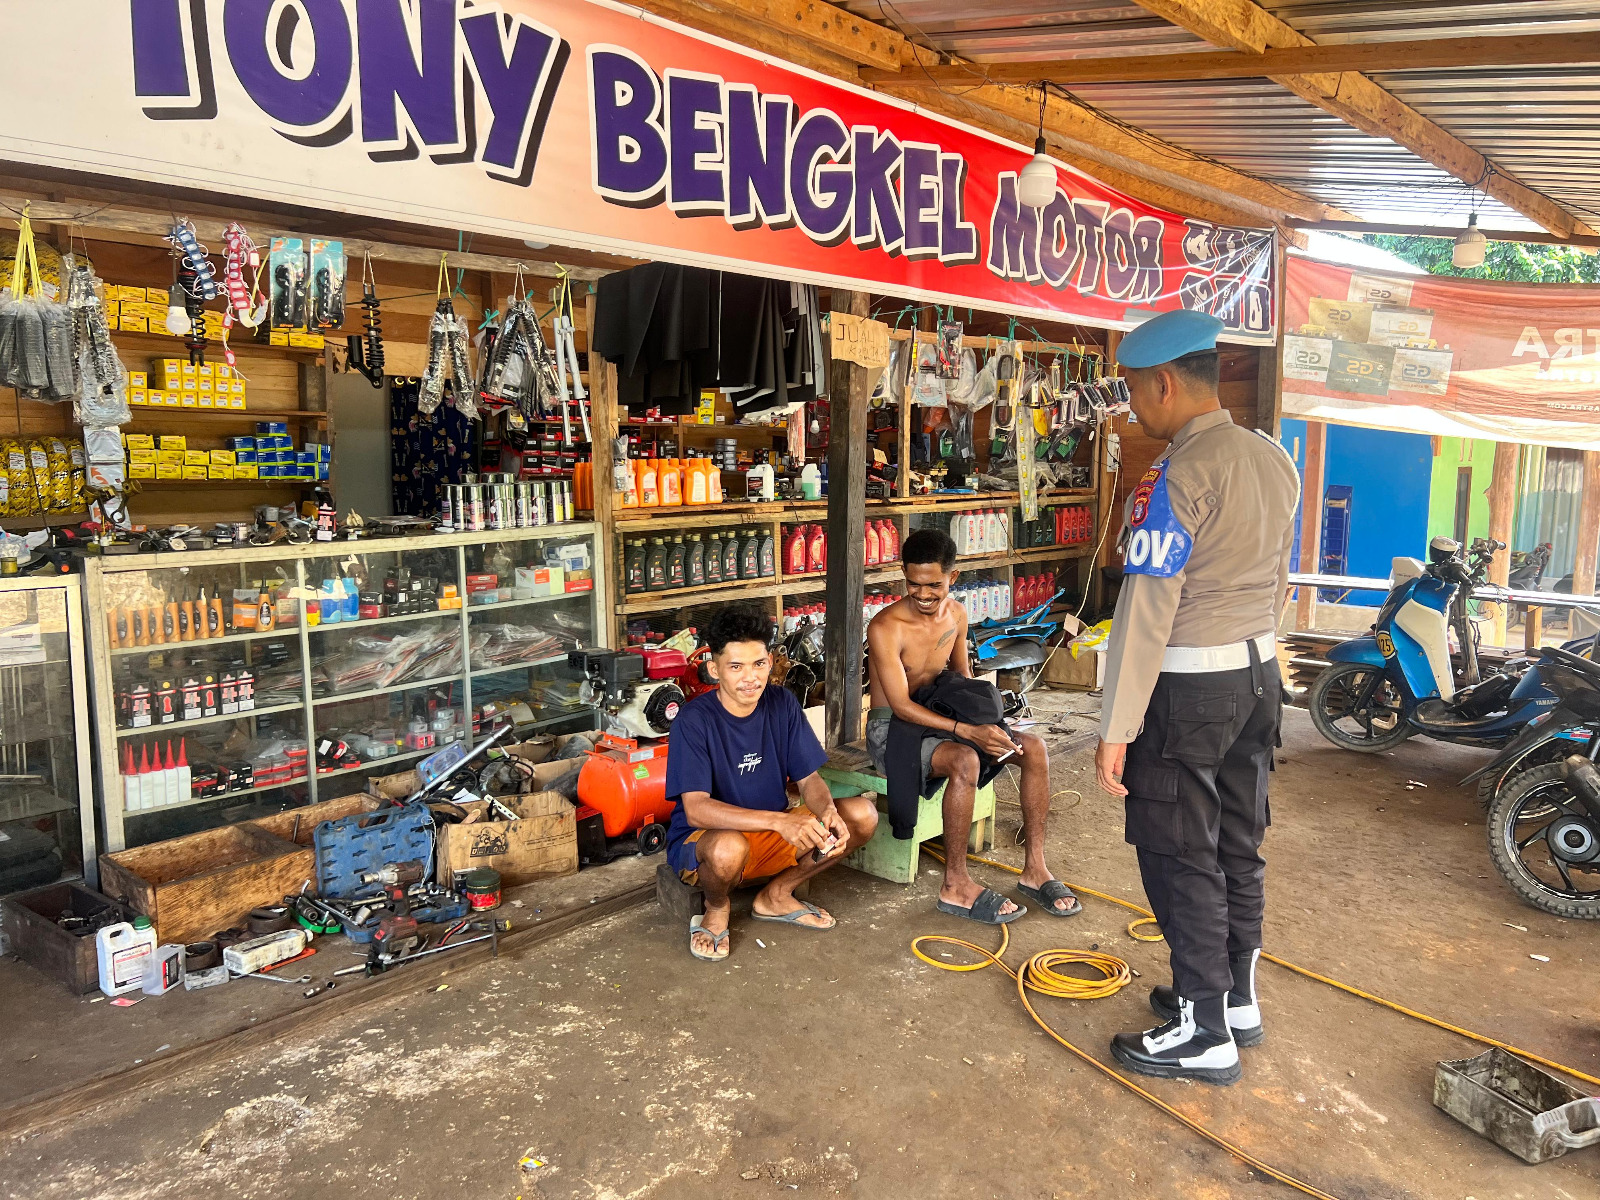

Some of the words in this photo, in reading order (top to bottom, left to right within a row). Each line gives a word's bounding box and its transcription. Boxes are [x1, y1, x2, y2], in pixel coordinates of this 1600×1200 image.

[586, 42, 978, 265] BENGKEL
[988, 170, 1165, 304] MOTOR
[1123, 529, 1174, 568] OV
